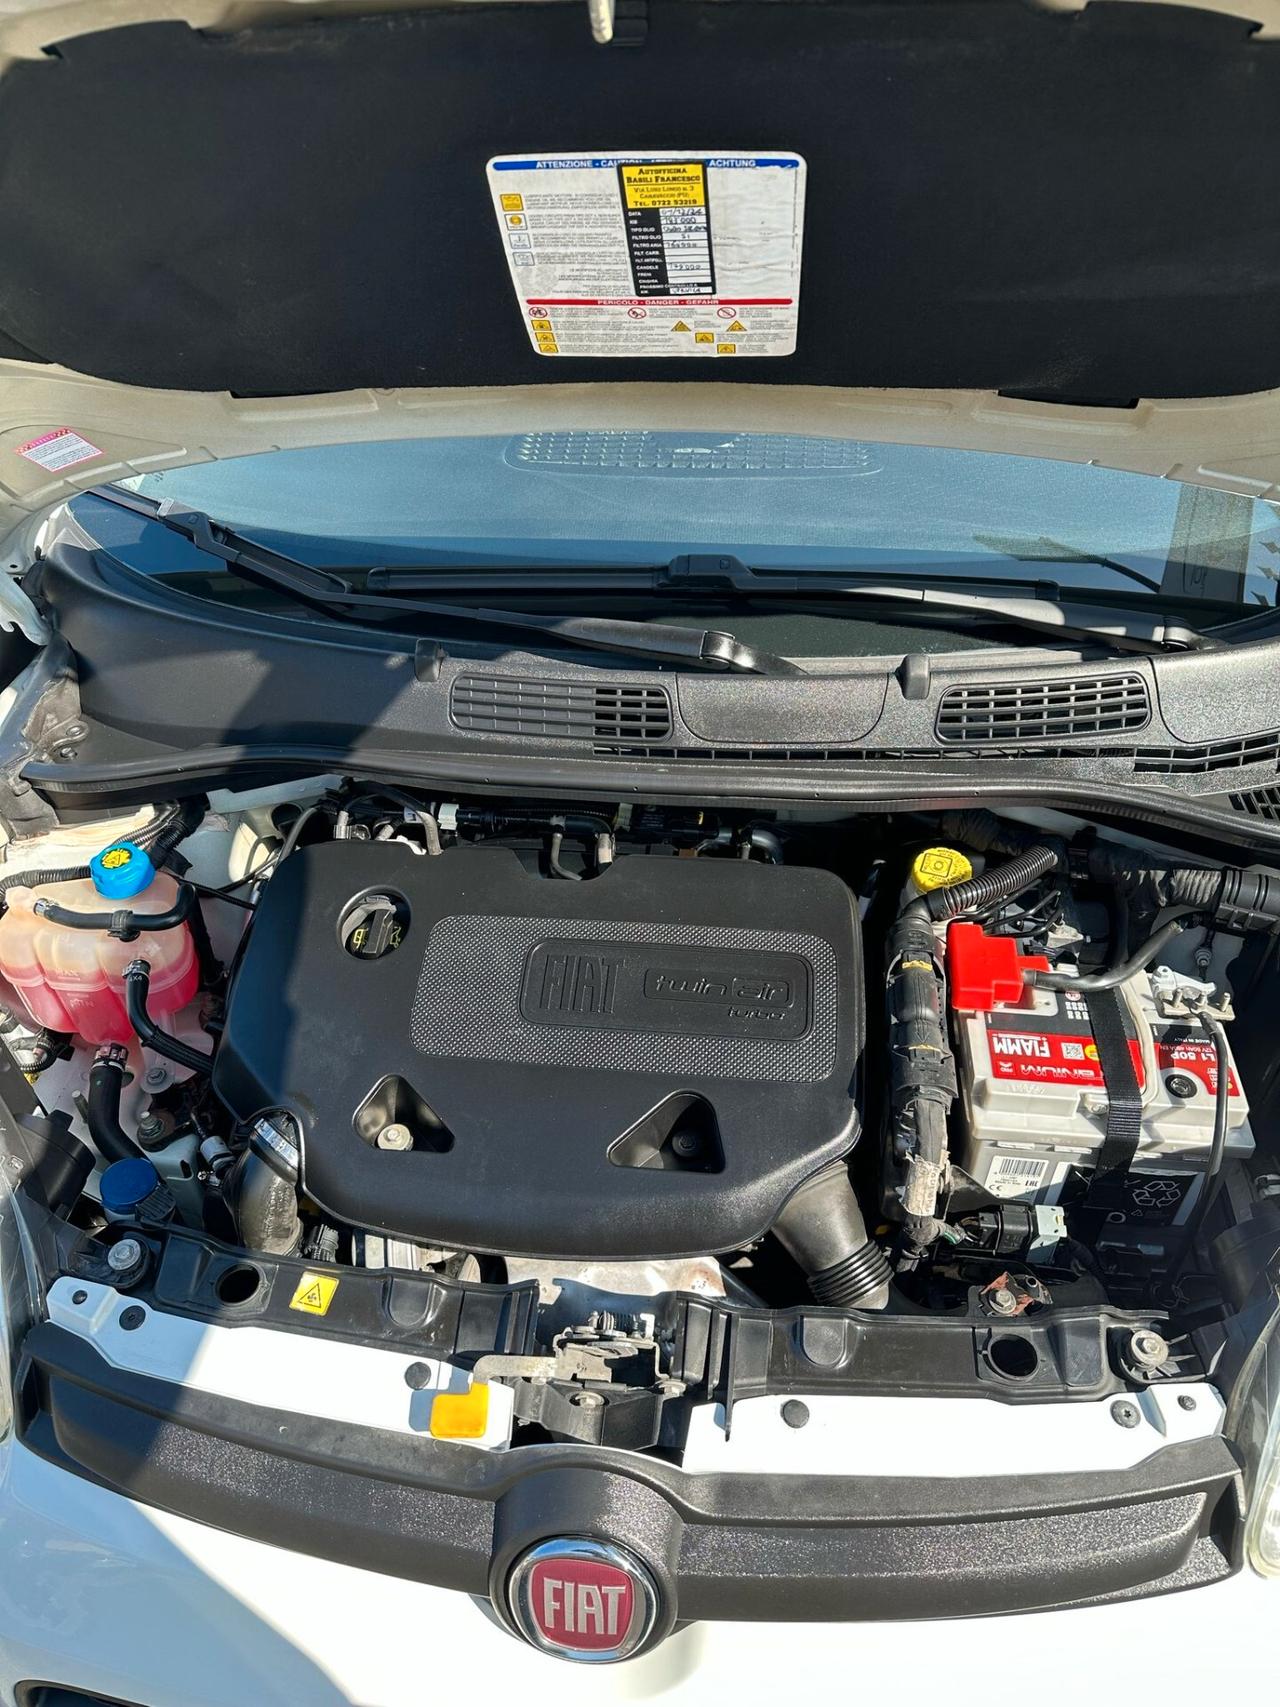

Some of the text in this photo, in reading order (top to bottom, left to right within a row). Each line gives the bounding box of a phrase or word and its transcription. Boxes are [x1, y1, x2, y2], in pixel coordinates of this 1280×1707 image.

[536, 160, 592, 169] ATTENZIONE
[709, 160, 756, 168] ACHTUNG
[539, 954, 623, 1014] FIAT
[728, 1006, 785, 1021] turbo
[992, 1036, 1051, 1058] FIAMM
[543, 1577, 626, 1635] FIAT
